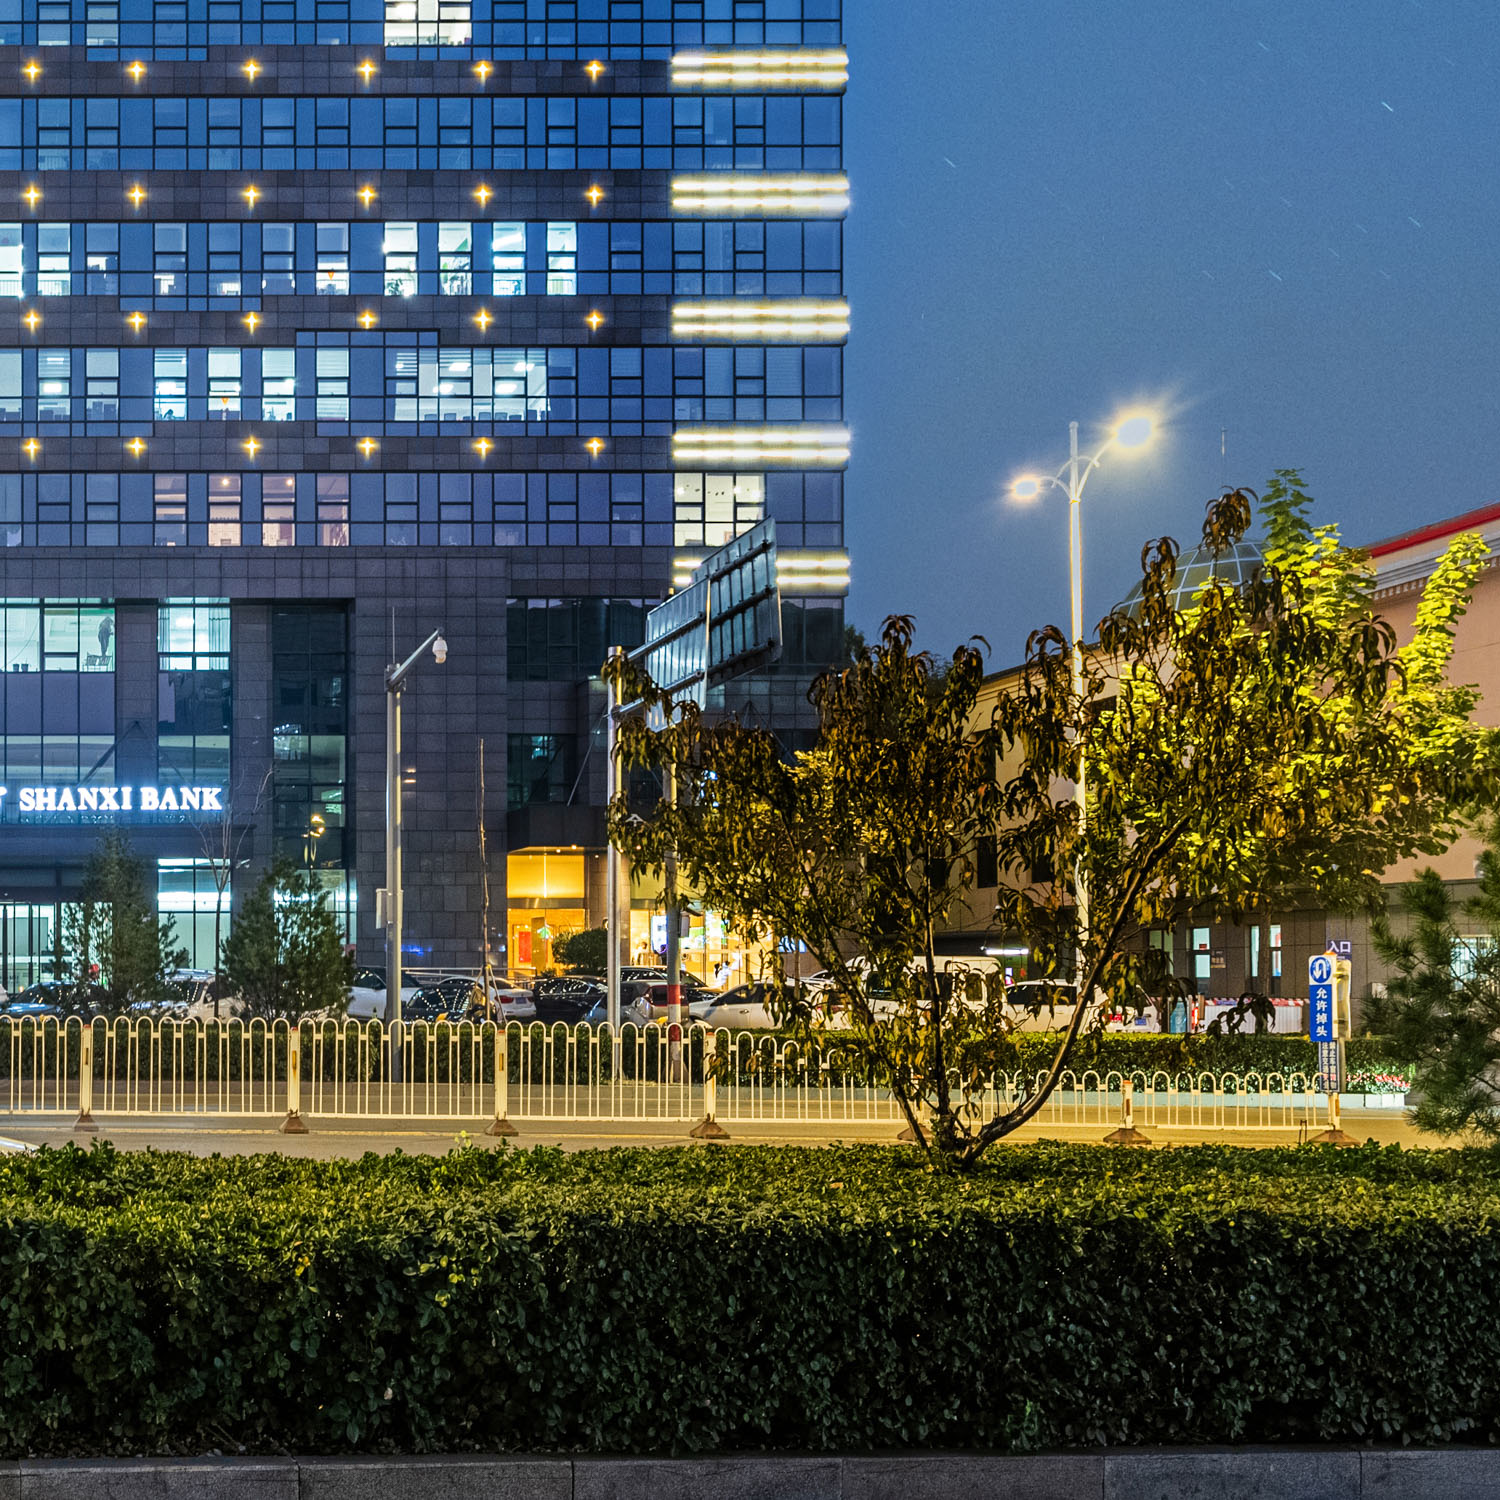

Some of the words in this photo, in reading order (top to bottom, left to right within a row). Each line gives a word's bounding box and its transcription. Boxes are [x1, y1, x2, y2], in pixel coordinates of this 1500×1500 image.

[19, 786, 132, 811] SHANXI
[140, 786, 222, 811] BANK
[1330, 940, 1351, 953] 入口
[1316, 987, 1328, 1037] 允许掉头
